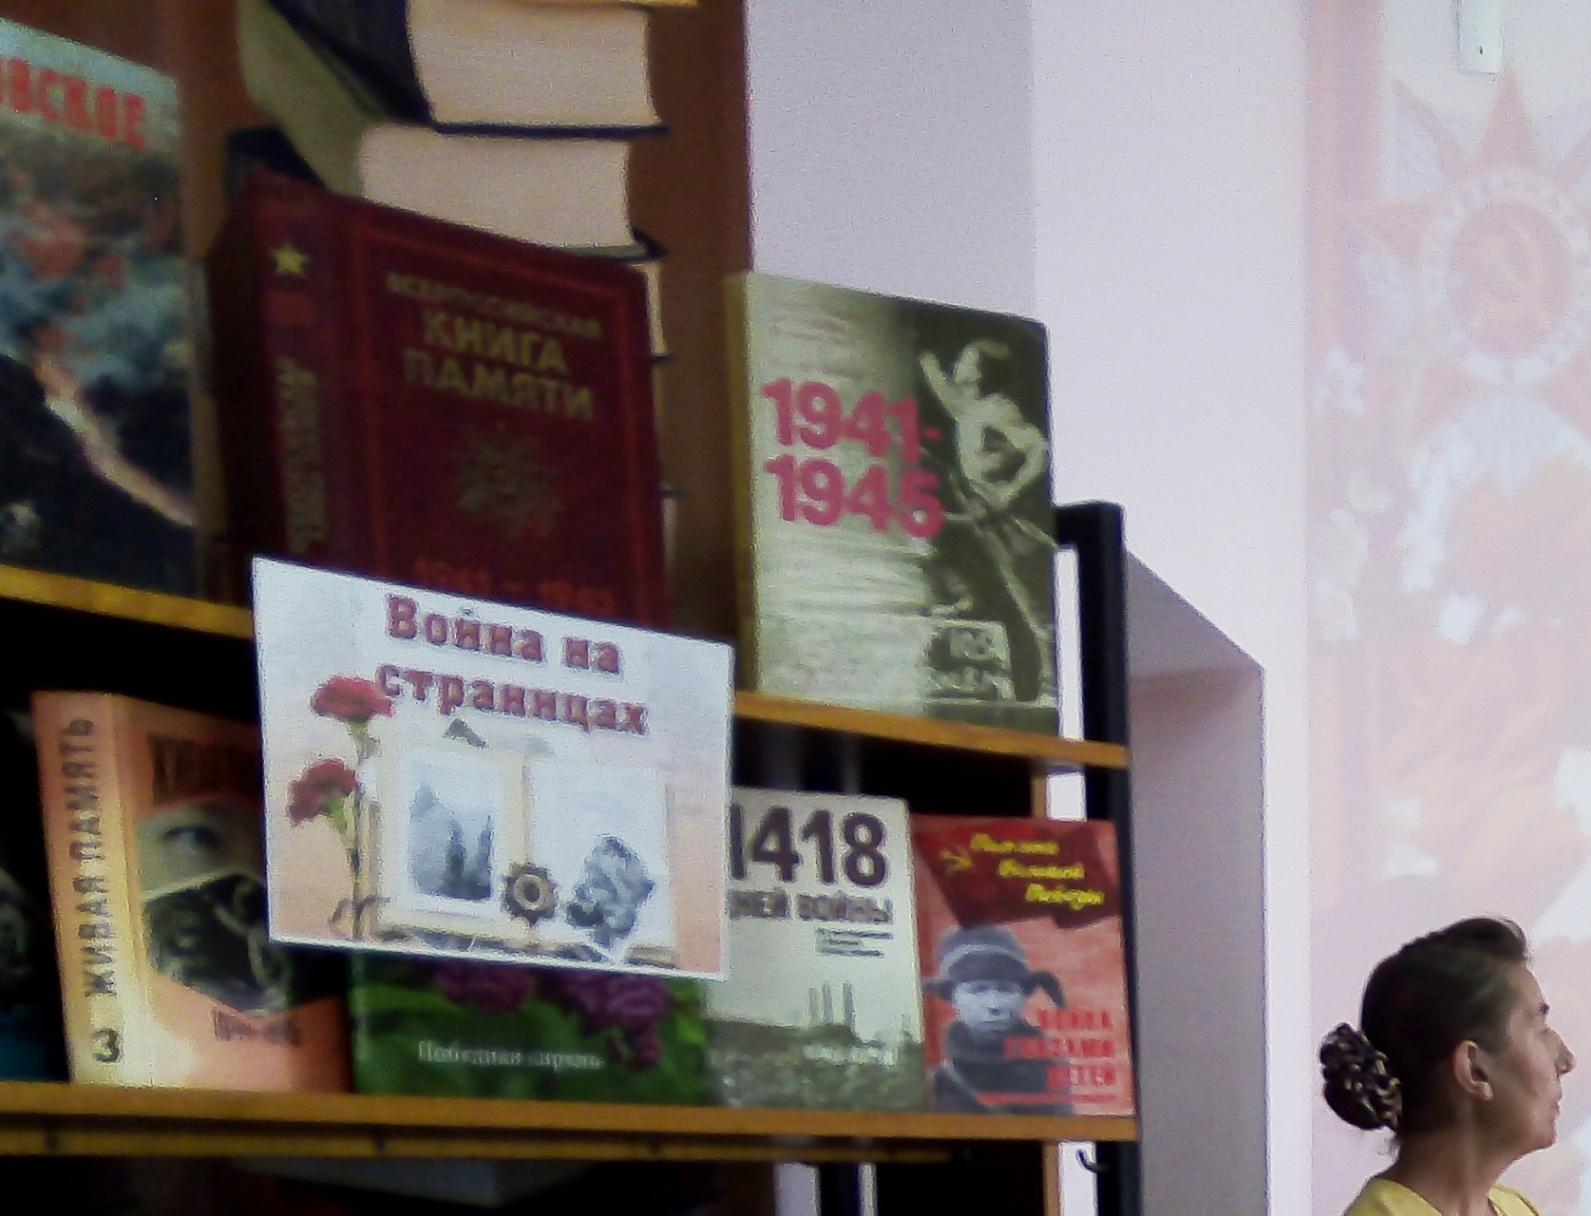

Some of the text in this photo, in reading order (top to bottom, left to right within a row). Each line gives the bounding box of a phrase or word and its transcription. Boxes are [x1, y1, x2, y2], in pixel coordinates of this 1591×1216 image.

[421, 306, 570, 375] КНИГА
[402, 347, 595, 423] ПАМЯТИ
[766, 455, 946, 540] 1945
[384, 593, 624, 676] Война на
[375, 662, 650, 736] страницах
[60, 717, 118, 1000] ЖИВАЯ ПАМЯТЬ
[729, 802, 889, 888] 1418
[93, 1028, 124, 1066] 3
